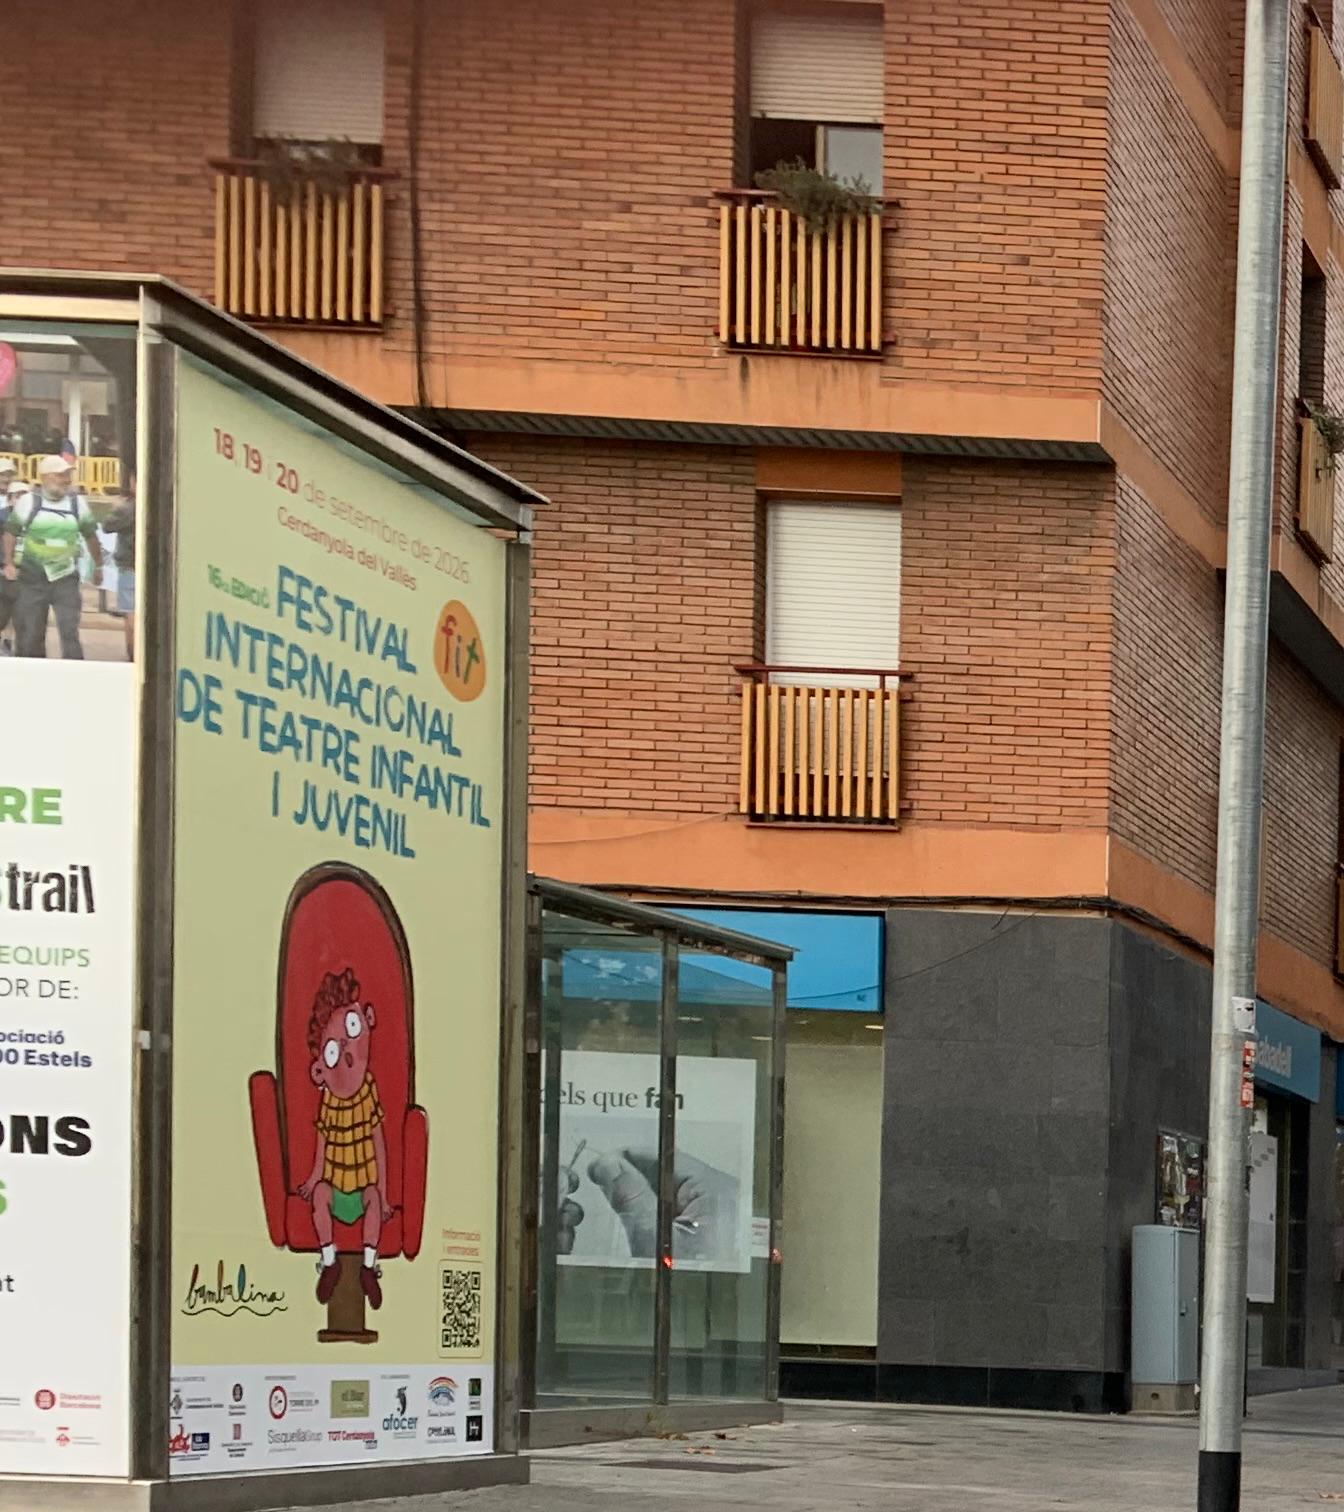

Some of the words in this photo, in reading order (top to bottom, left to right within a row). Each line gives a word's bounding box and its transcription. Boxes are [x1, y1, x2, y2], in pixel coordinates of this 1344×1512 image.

[242, 443, 262, 473] 19
[275, 461, 299, 494] 20
[304, 479, 325, 508] de
[410, 537, 431, 564] de
[276, 506, 356, 560] Cerdanyola
[357, 548, 378, 573] del
[275, 564, 418, 675] FESTIVAL
[440, 614, 481, 685] fit
[204, 610, 462, 758] INTERNACIONAL
[176, 667, 224, 736] DE
[234, 688, 361, 785] TEATRE
[369, 744, 491, 829] INFANTIL
[271, 770, 280, 818] I
[292, 779, 416, 859] JUVENIL
[38, 979, 79, 1000] DE:
[24, 1048, 93, 1068] Estels
[0, 1114, 92, 1157] NS
[591, 1090, 639, 1114] que
